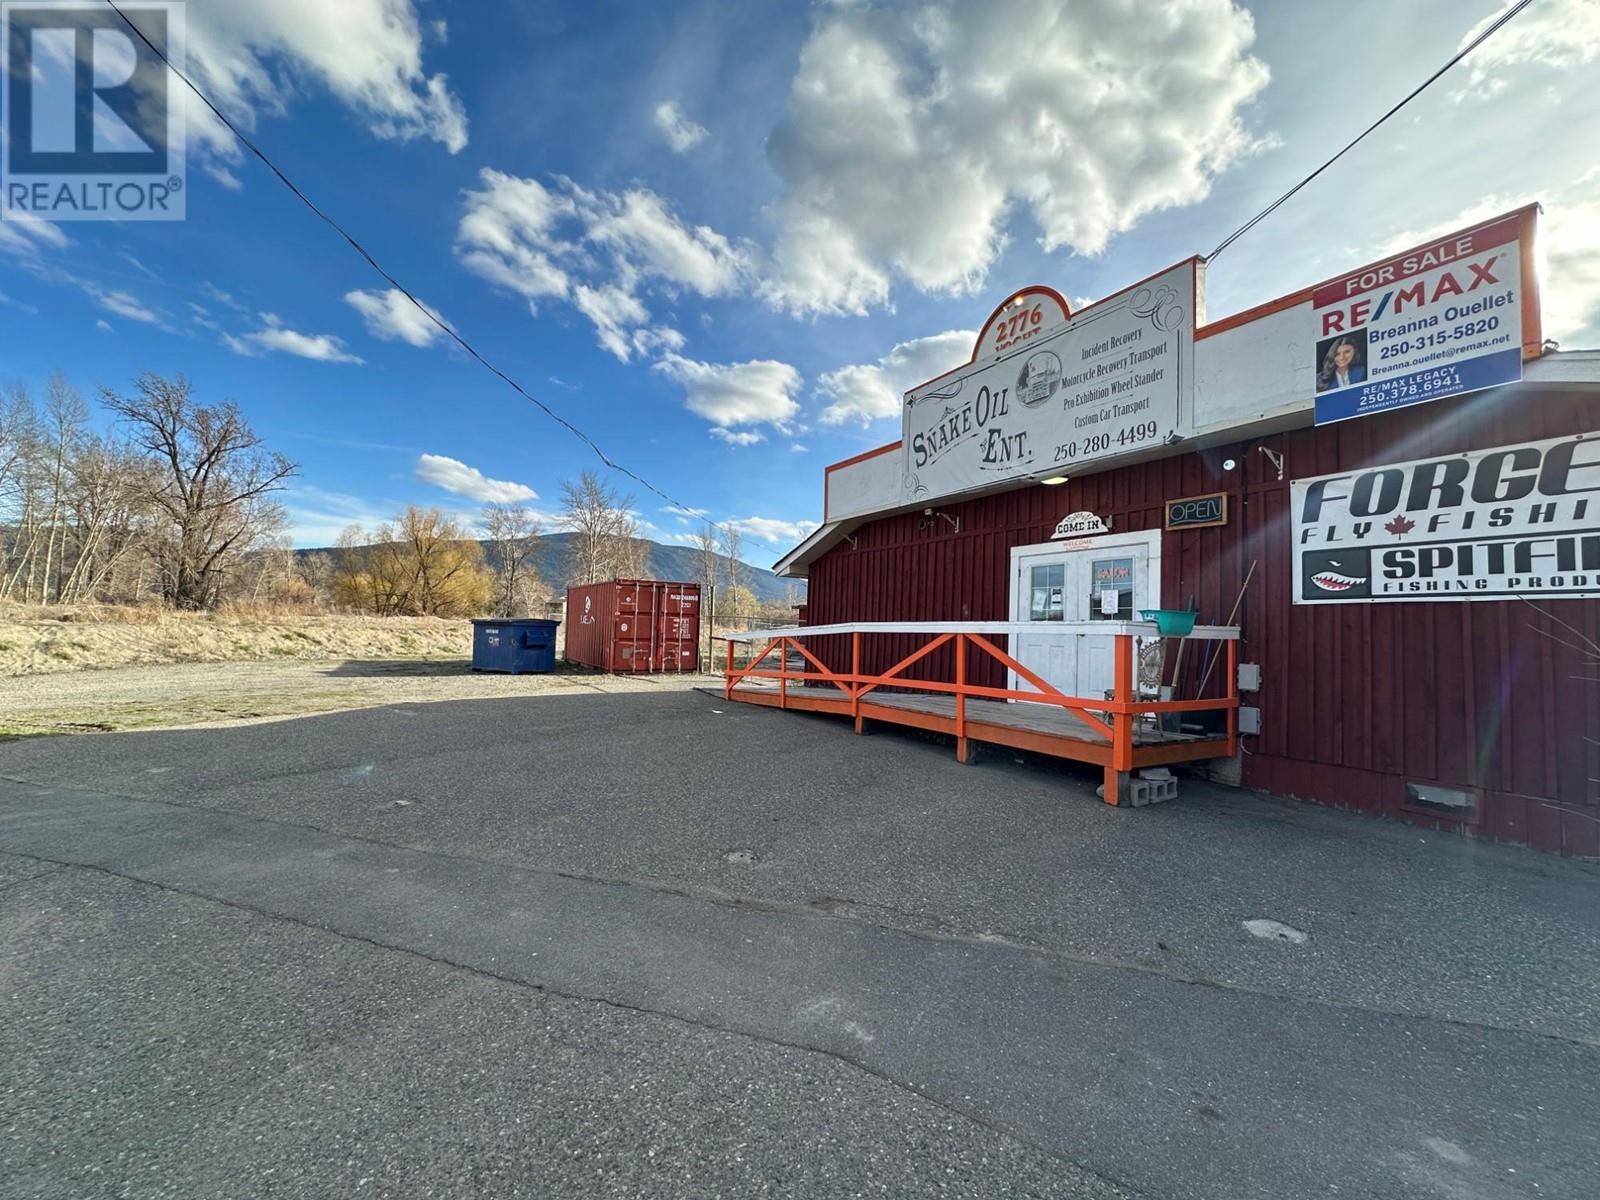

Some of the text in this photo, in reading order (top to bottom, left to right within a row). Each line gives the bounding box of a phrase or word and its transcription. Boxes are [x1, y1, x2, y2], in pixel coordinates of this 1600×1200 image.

[1346, 236, 1474, 295] FOR SALE
[1322, 255, 1500, 337] RE/MAX
[996, 303, 1043, 342] 2776
[1369, 290, 1515, 345] Breanna Ouellet
[1380, 315, 1499, 360] 250-315-5820
[1081, 327, 1143, 360] Incident Recovery
[1371, 333, 1511, 376] Breanna.ouellet@remax.net
[1061, 341, 1168, 389] Motorcycle Recovery Transport
[1363, 366, 1456, 395] RE/MAX LEGACY
[1063, 368, 1165, 411] Pro Exhibition Wheel Stander
[1359, 374, 1462, 406] 250.378.6941
[913, 385, 1009, 468] SNAKE OIL
[1074, 397, 1150, 429] Custom Car Transport
[982, 428, 1032, 464] ENT.
[1054, 420, 1158, 462] 250-280-4499
[1057, 519, 1100, 534] COME IN
[1170, 496, 1222, 522] OPEN
[1301, 499, 1589, 544] FLY FISHI
[1383, 578, 1488, 592] FISHING
